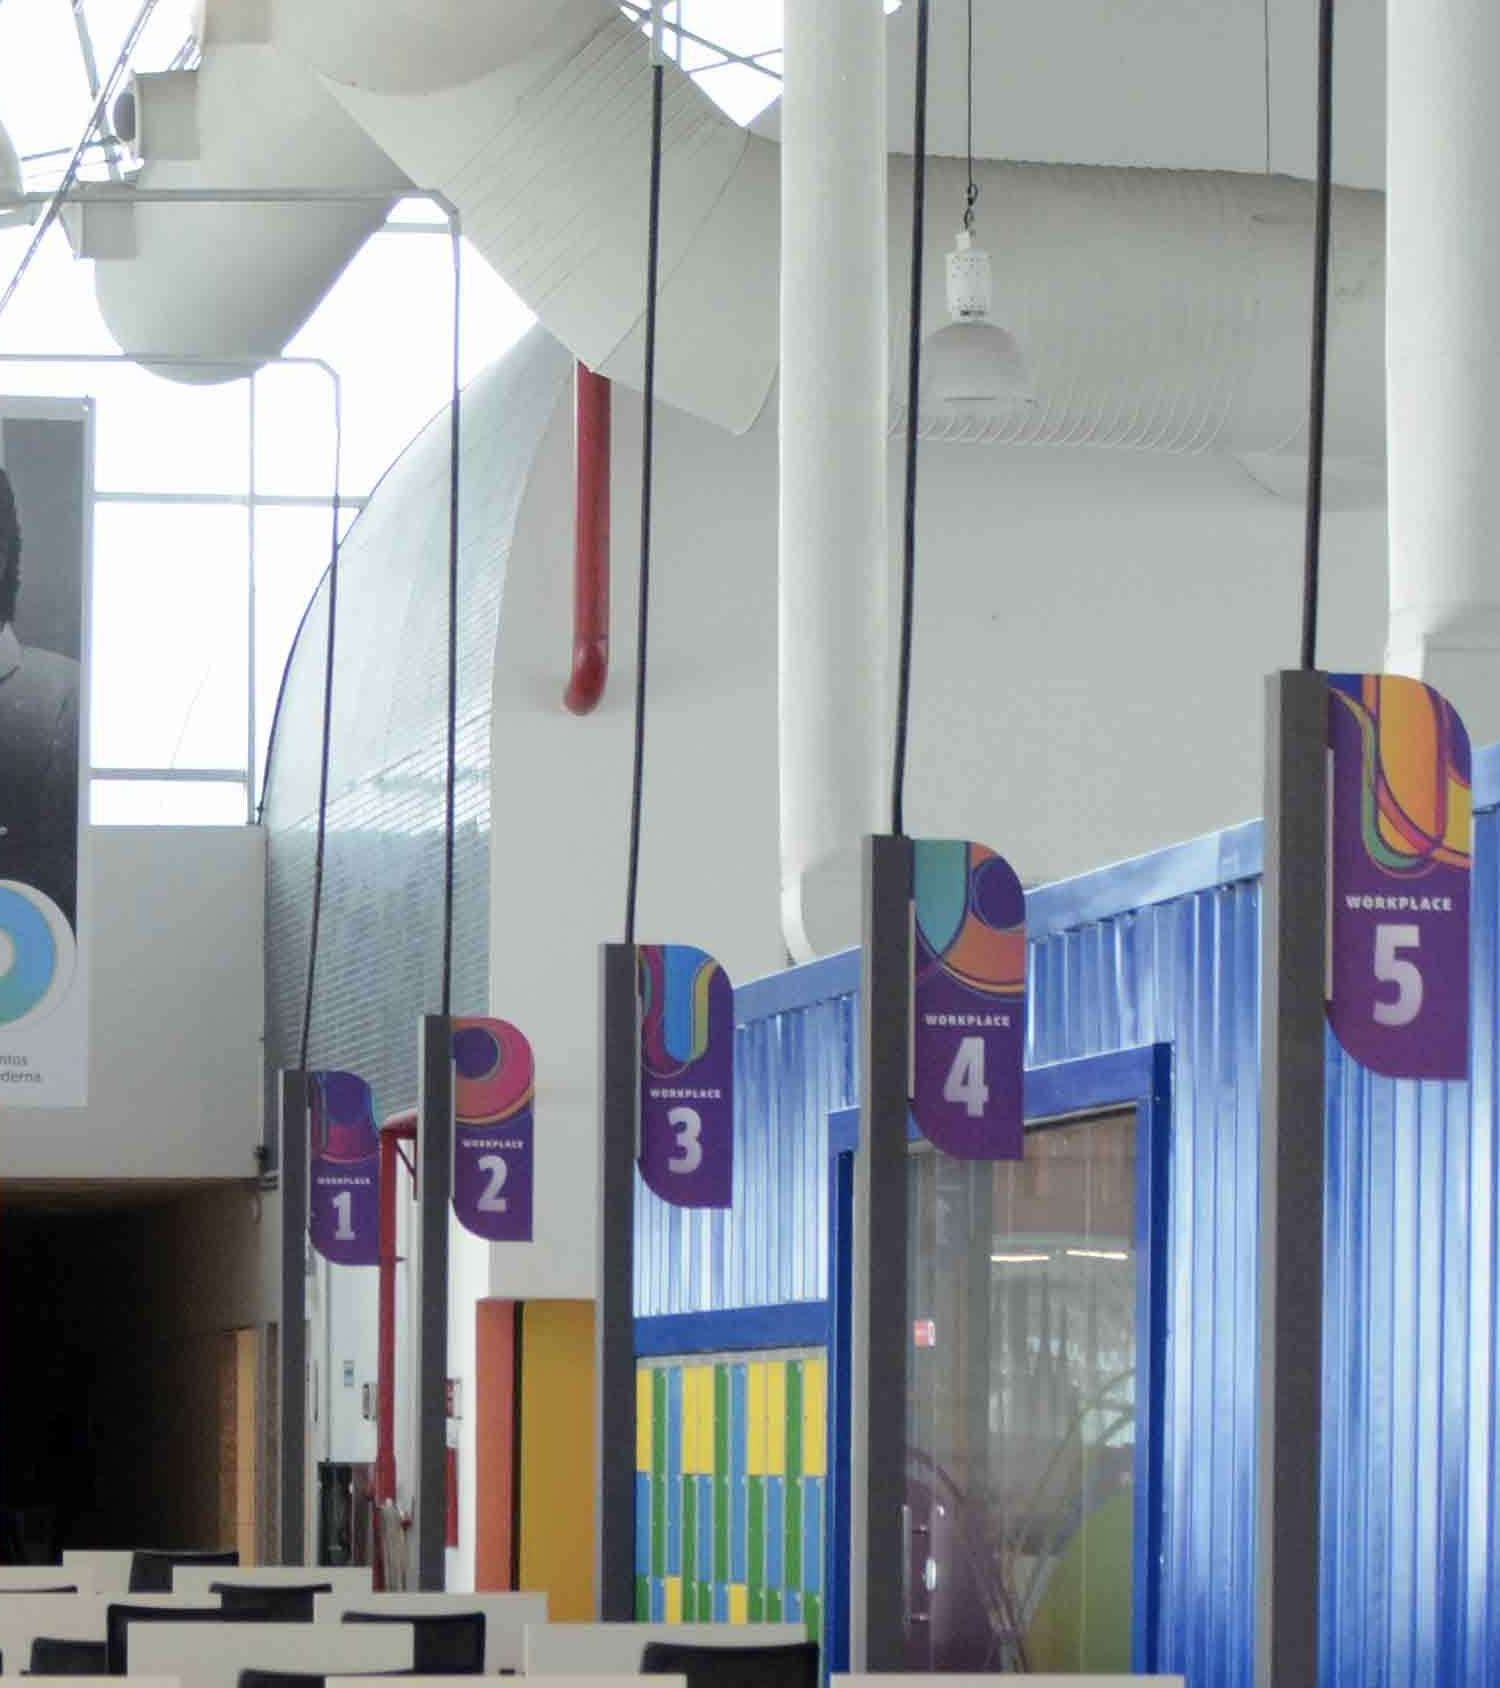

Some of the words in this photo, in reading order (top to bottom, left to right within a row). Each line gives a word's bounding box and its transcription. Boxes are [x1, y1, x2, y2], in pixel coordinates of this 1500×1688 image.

[1345, 895, 1453, 911] WORKPLACE
[1373, 923, 1423, 1026] 5
[924, 1013, 1011, 1028] WORKPLACE
[649, 1087, 721, 1099] WORKPLACE
[943, 1036, 989, 1117] 4
[463, 1138, 524, 1149] WORKPLACE
[667, 1107, 703, 1174] 3
[476, 1155, 508, 1213] 2
[332, 1191, 356, 1241] 1
